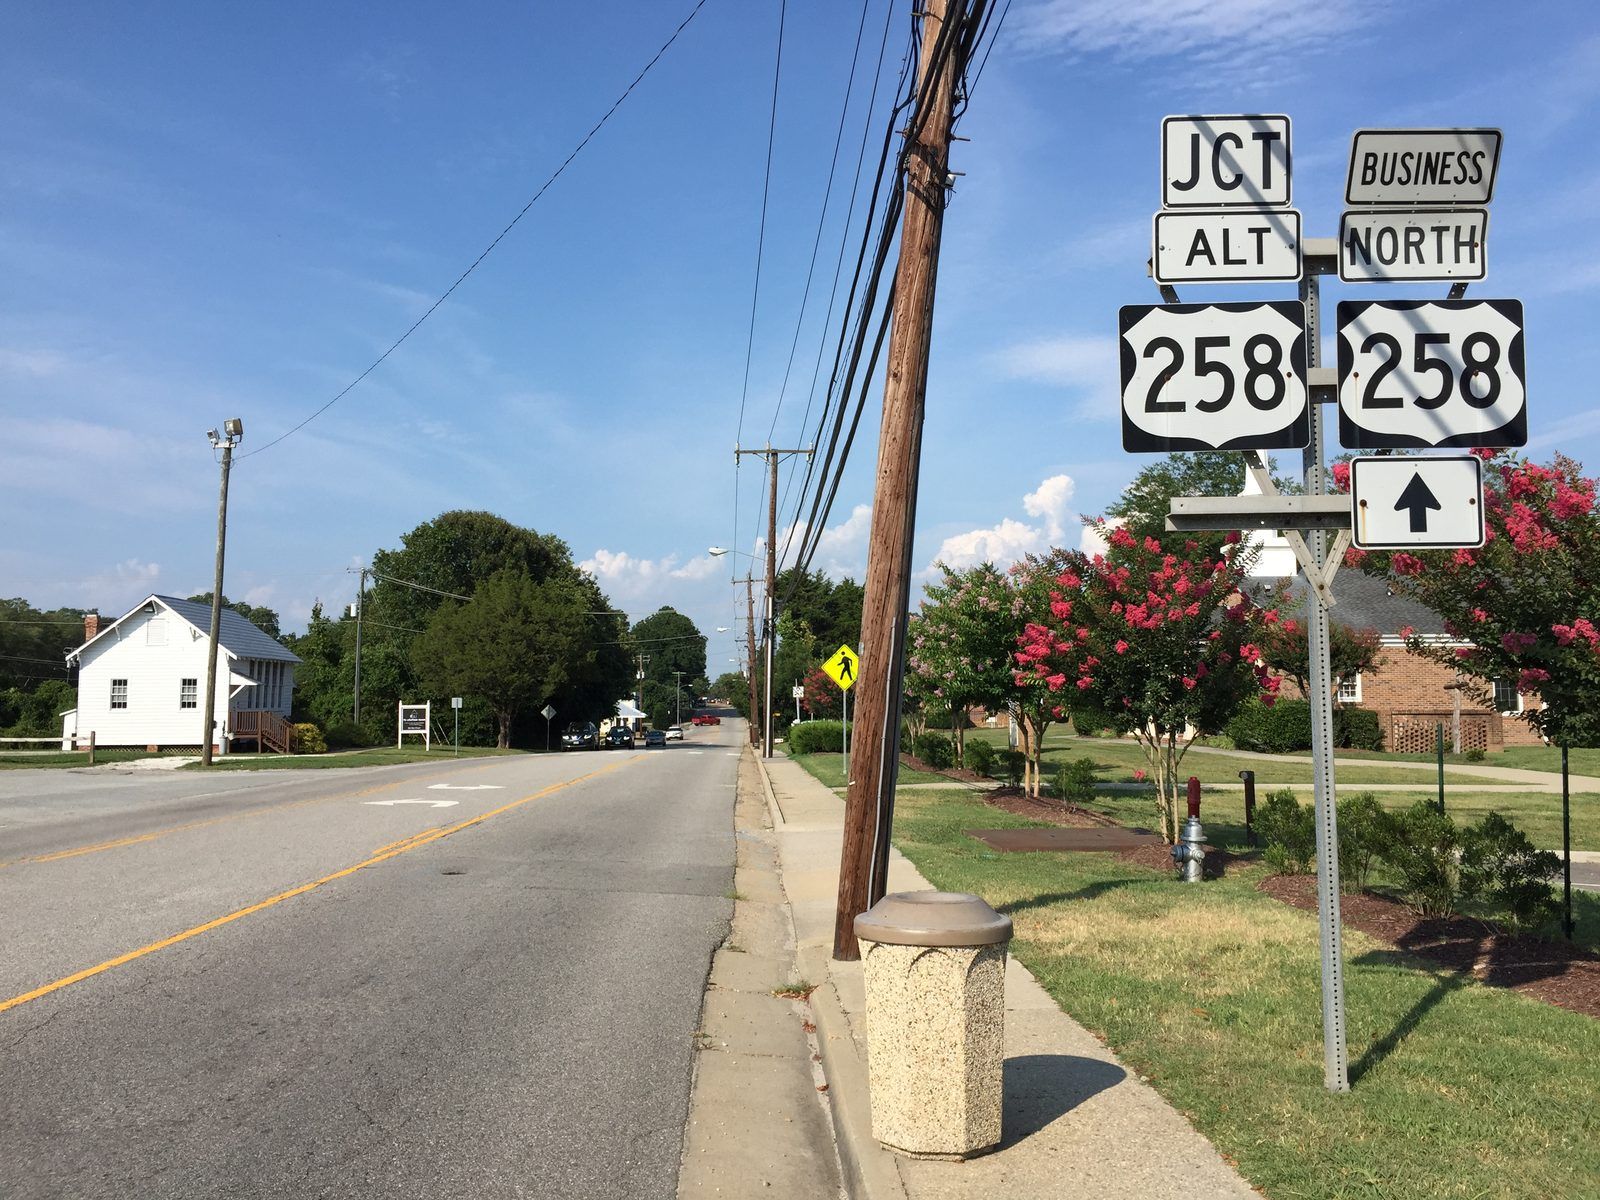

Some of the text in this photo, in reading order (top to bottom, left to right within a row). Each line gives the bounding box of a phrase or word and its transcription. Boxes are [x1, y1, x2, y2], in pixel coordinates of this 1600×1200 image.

[1171, 131, 1281, 191] JCT
[1361, 150, 1486, 186] BUSINESS
[1185, 227, 1271, 266] ALT
[1349, 225, 1477, 266] NORTH
[1142, 333, 1286, 413] 258
[1360, 331, 1501, 410] 258
